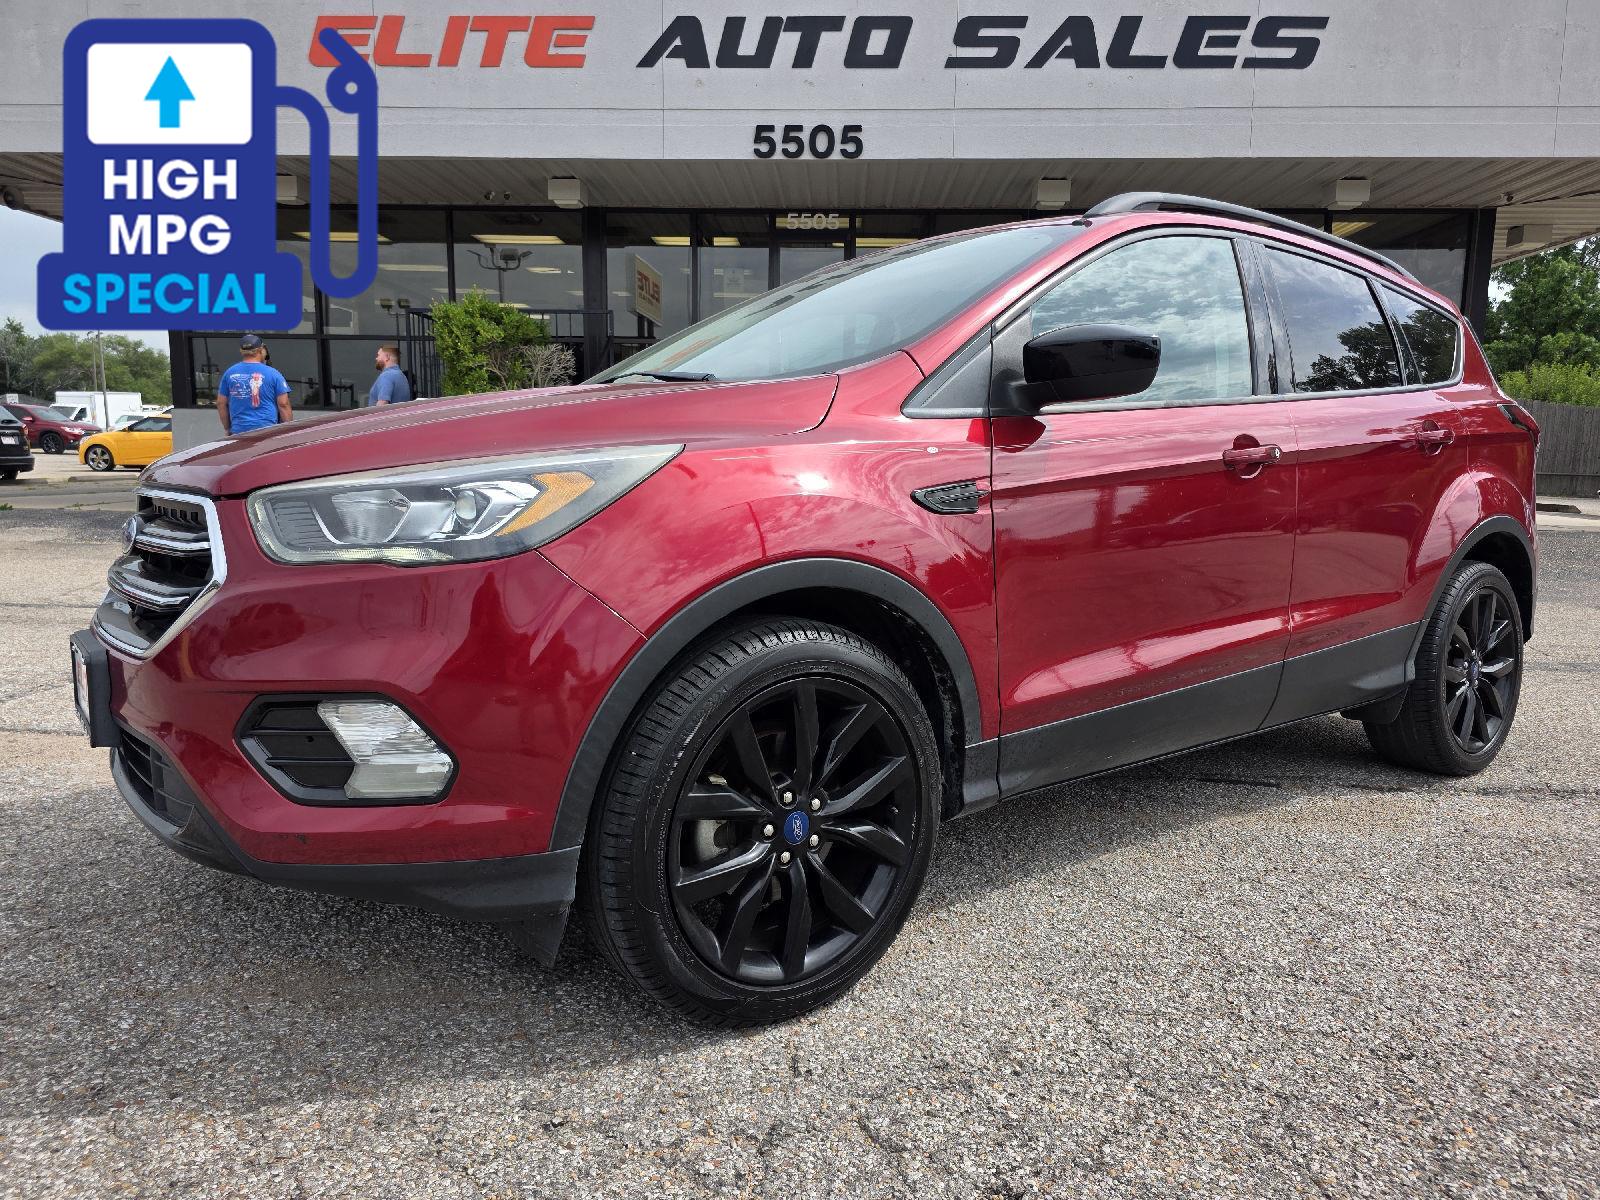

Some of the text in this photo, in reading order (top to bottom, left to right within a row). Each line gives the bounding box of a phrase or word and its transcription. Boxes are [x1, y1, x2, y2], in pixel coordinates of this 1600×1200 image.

[308, 16, 1330, 70] ELITE AUTO SALES
[753, 125, 864, 159] 5505
[787, 213, 840, 229] 5505
